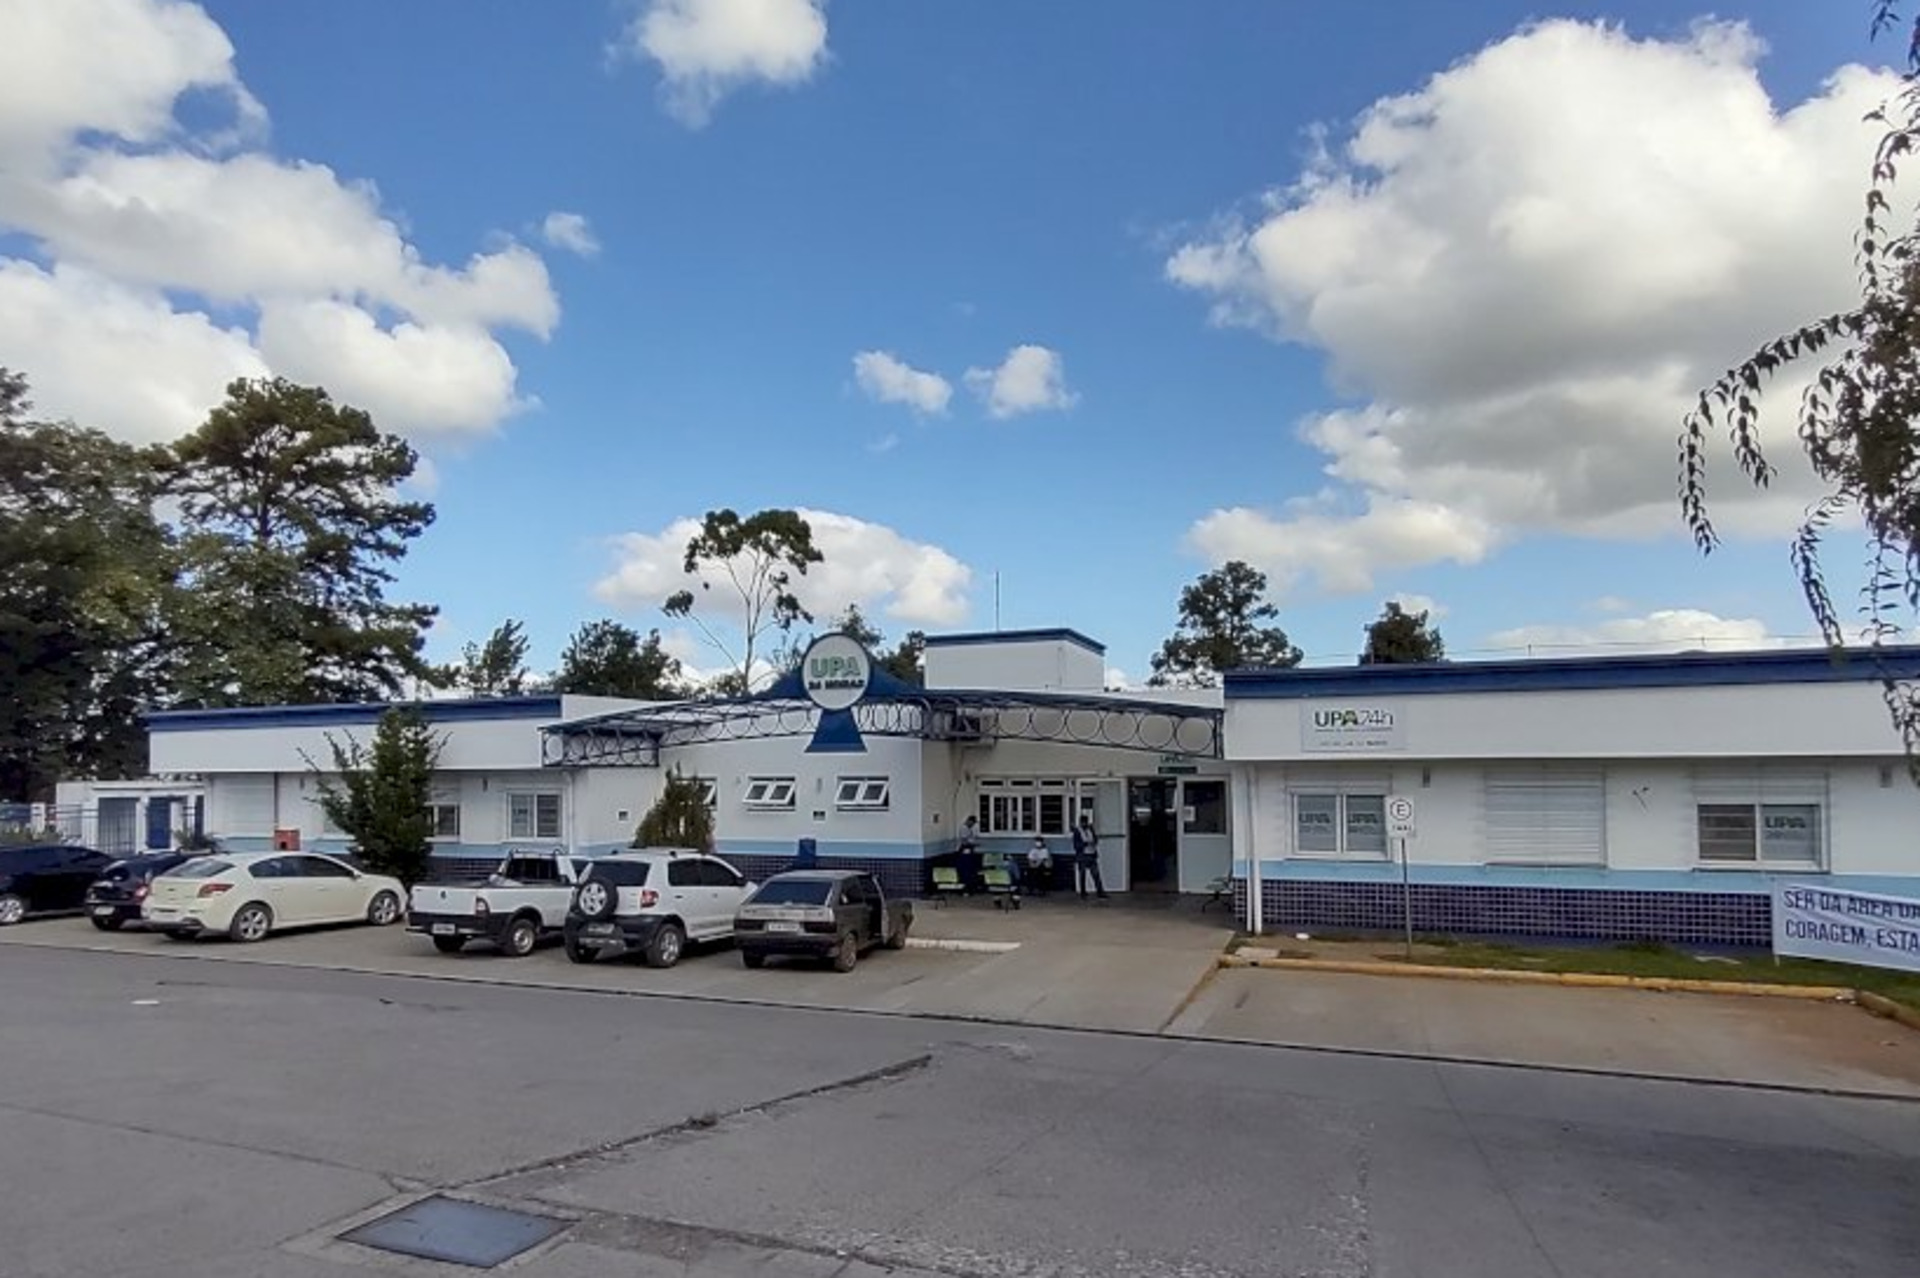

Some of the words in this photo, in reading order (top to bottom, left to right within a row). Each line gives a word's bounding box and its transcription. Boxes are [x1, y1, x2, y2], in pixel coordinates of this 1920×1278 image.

[811, 656, 861, 678] UPA
[1396, 803, 1406, 817] E
[1783, 889, 1816, 911] SER
[1820, 891, 1842, 913] DA
[1786, 919, 1871, 948] CORAGEM,
